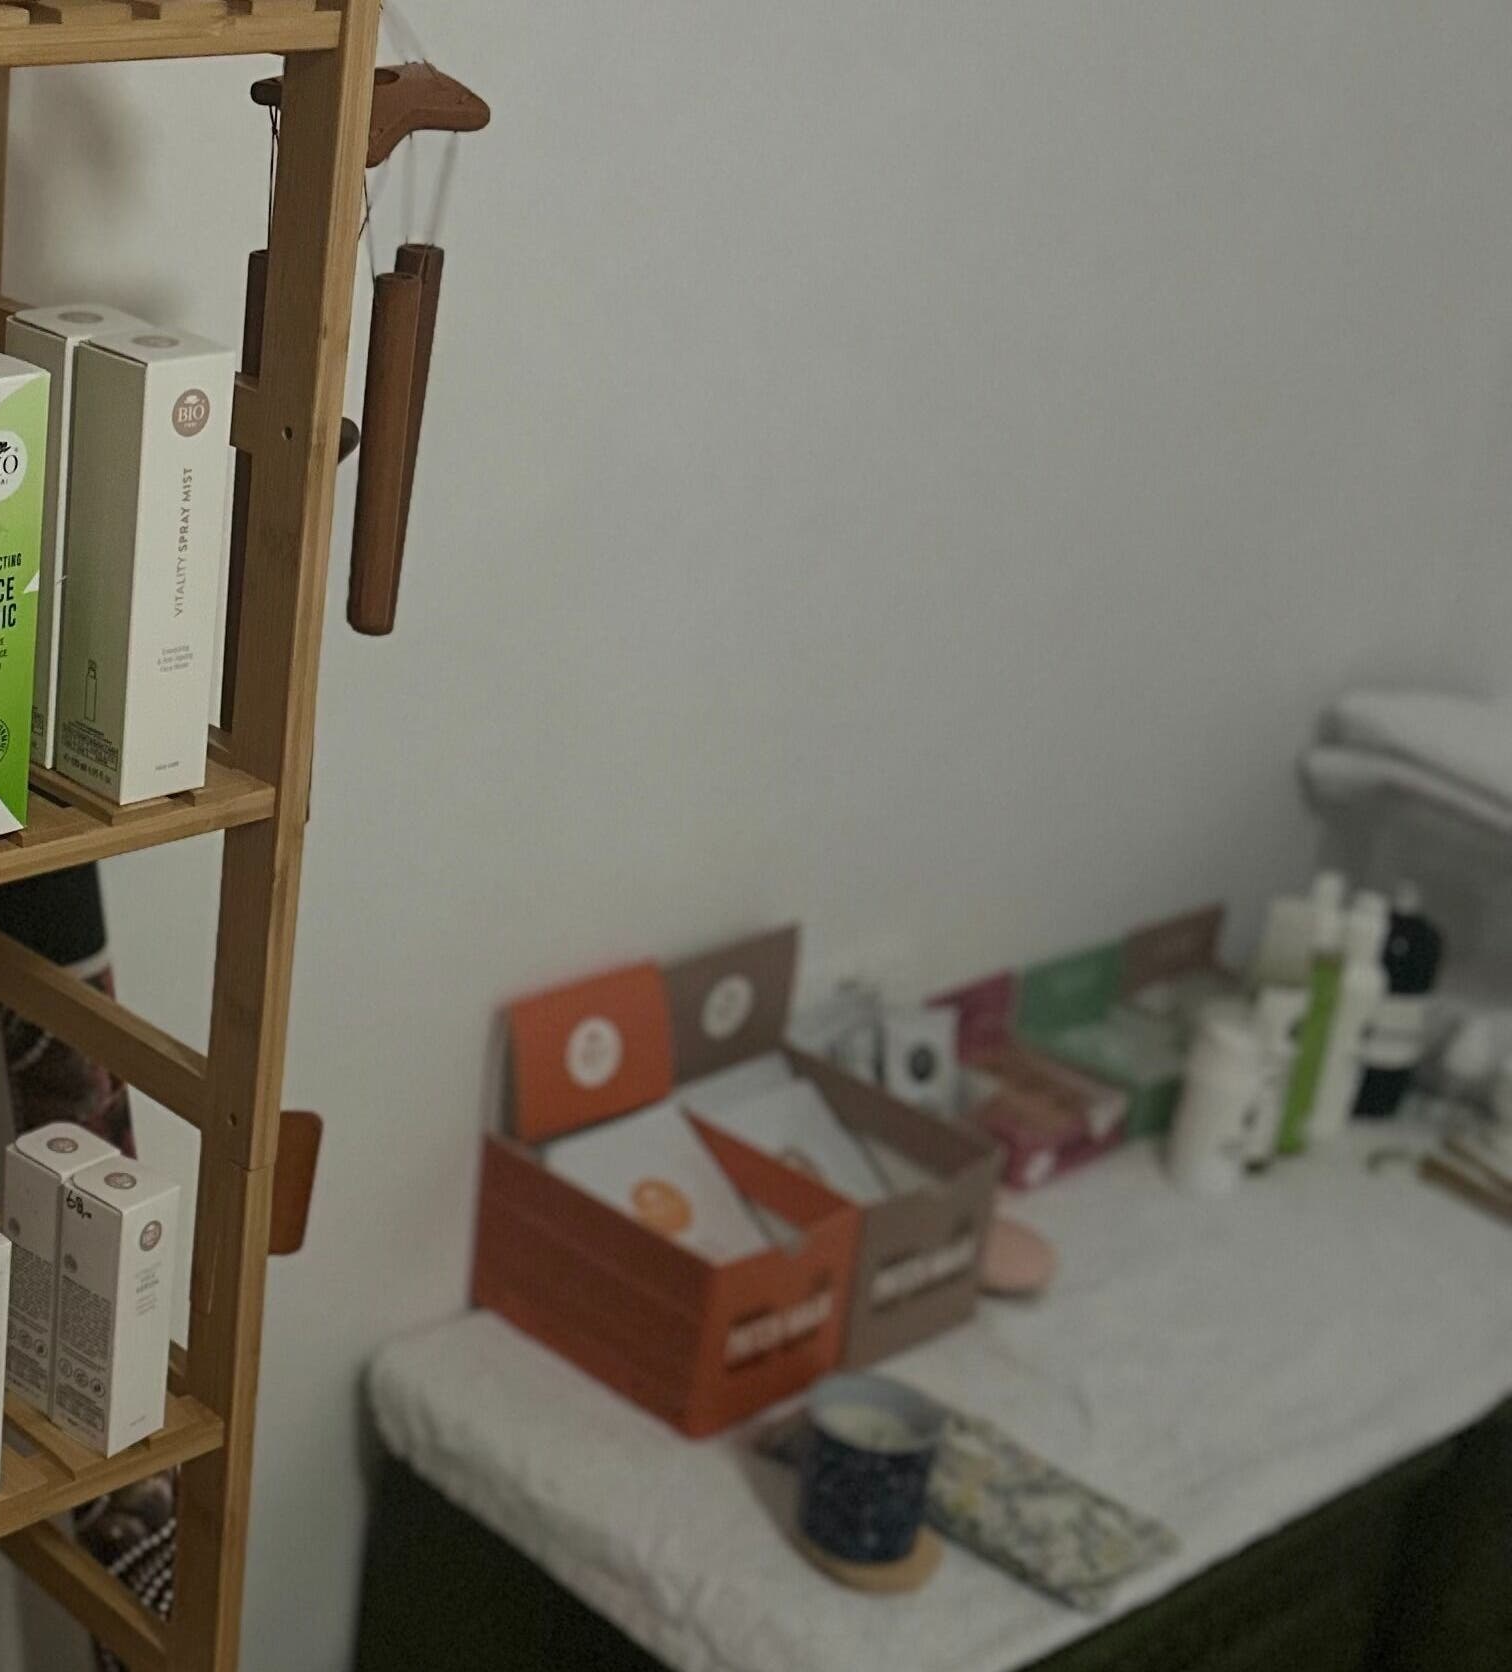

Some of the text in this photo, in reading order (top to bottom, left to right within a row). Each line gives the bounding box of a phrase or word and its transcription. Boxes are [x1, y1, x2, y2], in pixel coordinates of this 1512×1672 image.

[178, 404, 205, 423] BIO
[174, 468, 193, 618] VITALITY SPRAY MIST
